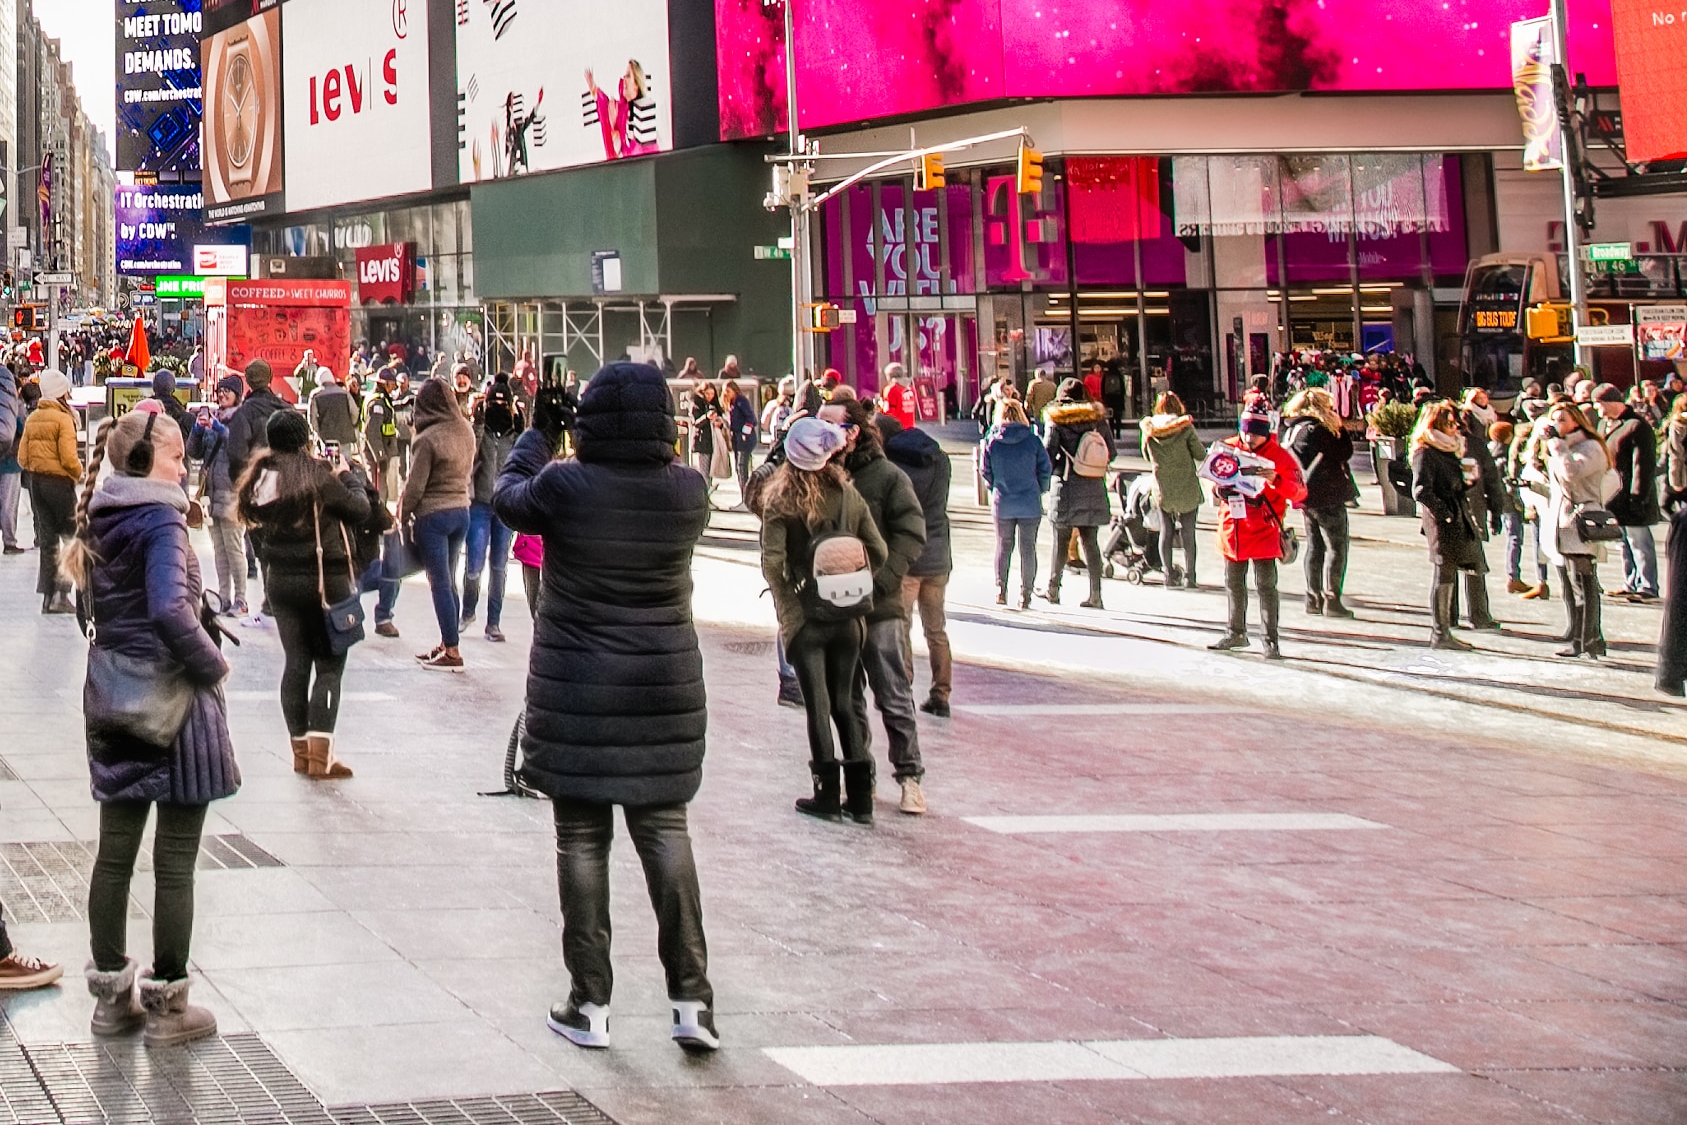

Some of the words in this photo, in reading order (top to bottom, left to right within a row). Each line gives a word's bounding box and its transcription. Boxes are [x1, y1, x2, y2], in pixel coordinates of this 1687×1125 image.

[1652, 11, 1674, 26] No
[124, 15, 160, 39] MEET
[124, 48, 196, 74] DEMANDS.
[120, 193, 132, 209] IT
[121, 225, 135, 241] by
[867, 207, 940, 244] ARE
[1593, 246, 1630, 259] Broadway
[120, 260, 181, 270] CDW.com/orchestration
[866, 243, 941, 280] YOU
[1598, 260, 1608, 271] W
[1611, 260, 1626, 271] 46
[231, 287, 285, 299] COFFEED
[291, 288, 313, 299] SWEET
[314, 288, 347, 299] CHURROS
[1476, 311, 1486, 327] BIG
[1486, 311, 1499, 327] BUS
